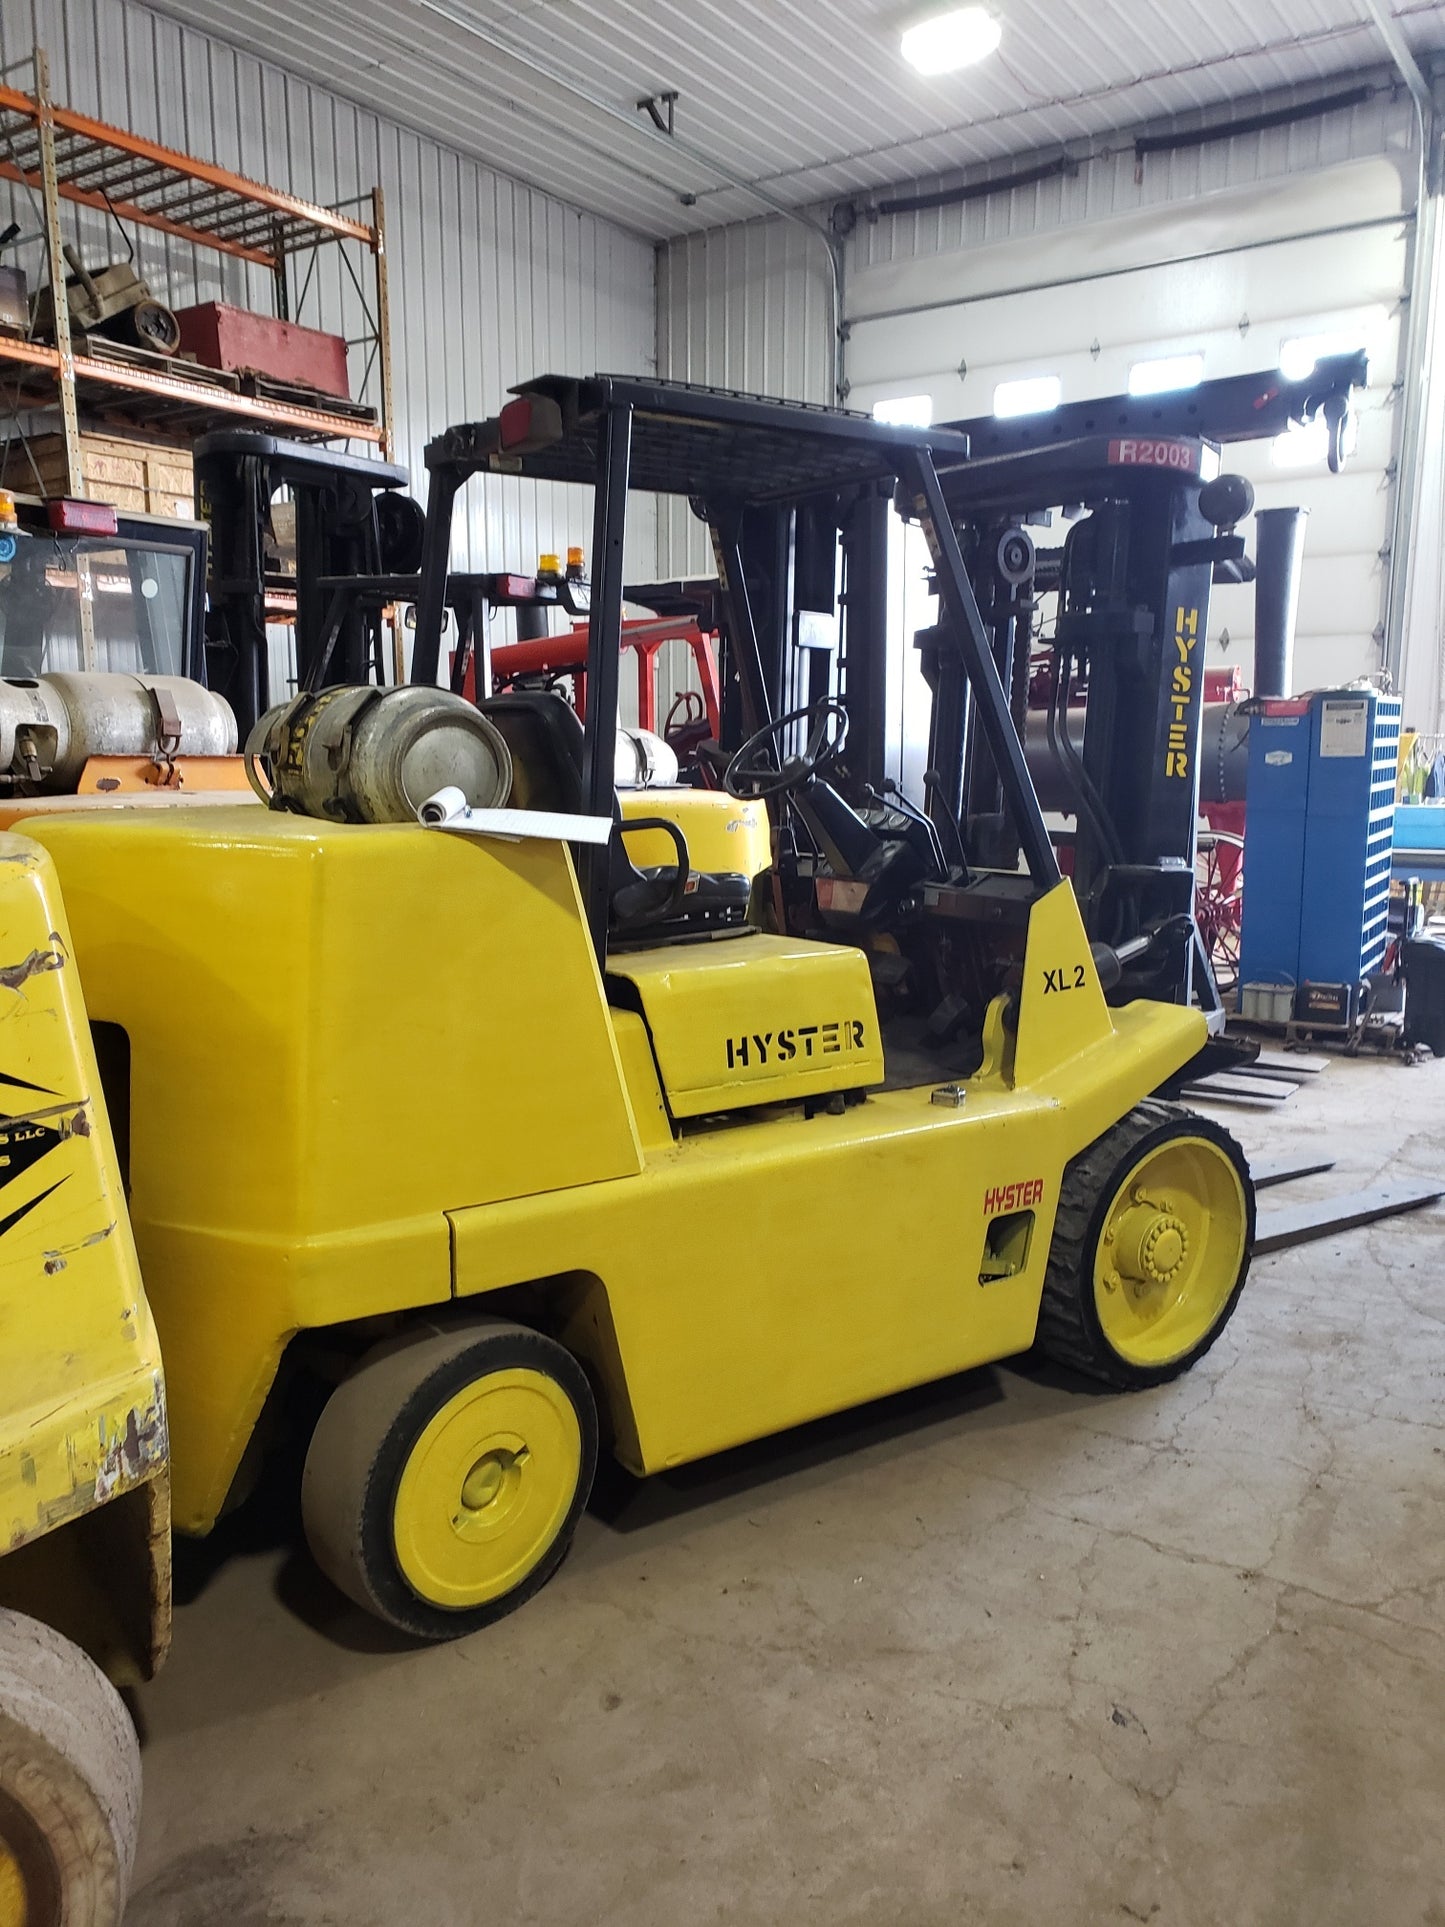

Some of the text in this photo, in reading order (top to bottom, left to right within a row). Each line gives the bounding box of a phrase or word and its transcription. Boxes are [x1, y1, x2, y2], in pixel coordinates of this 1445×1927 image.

[1119, 440, 1191, 469] R2003
[1165, 606, 1198, 777] HYSTER
[1043, 965, 1086, 994] XL2
[726, 1020, 865, 1068] HYSTER
[14, 1127, 46, 1142] LLC
[983, 1178, 1044, 1216] HYSTER
